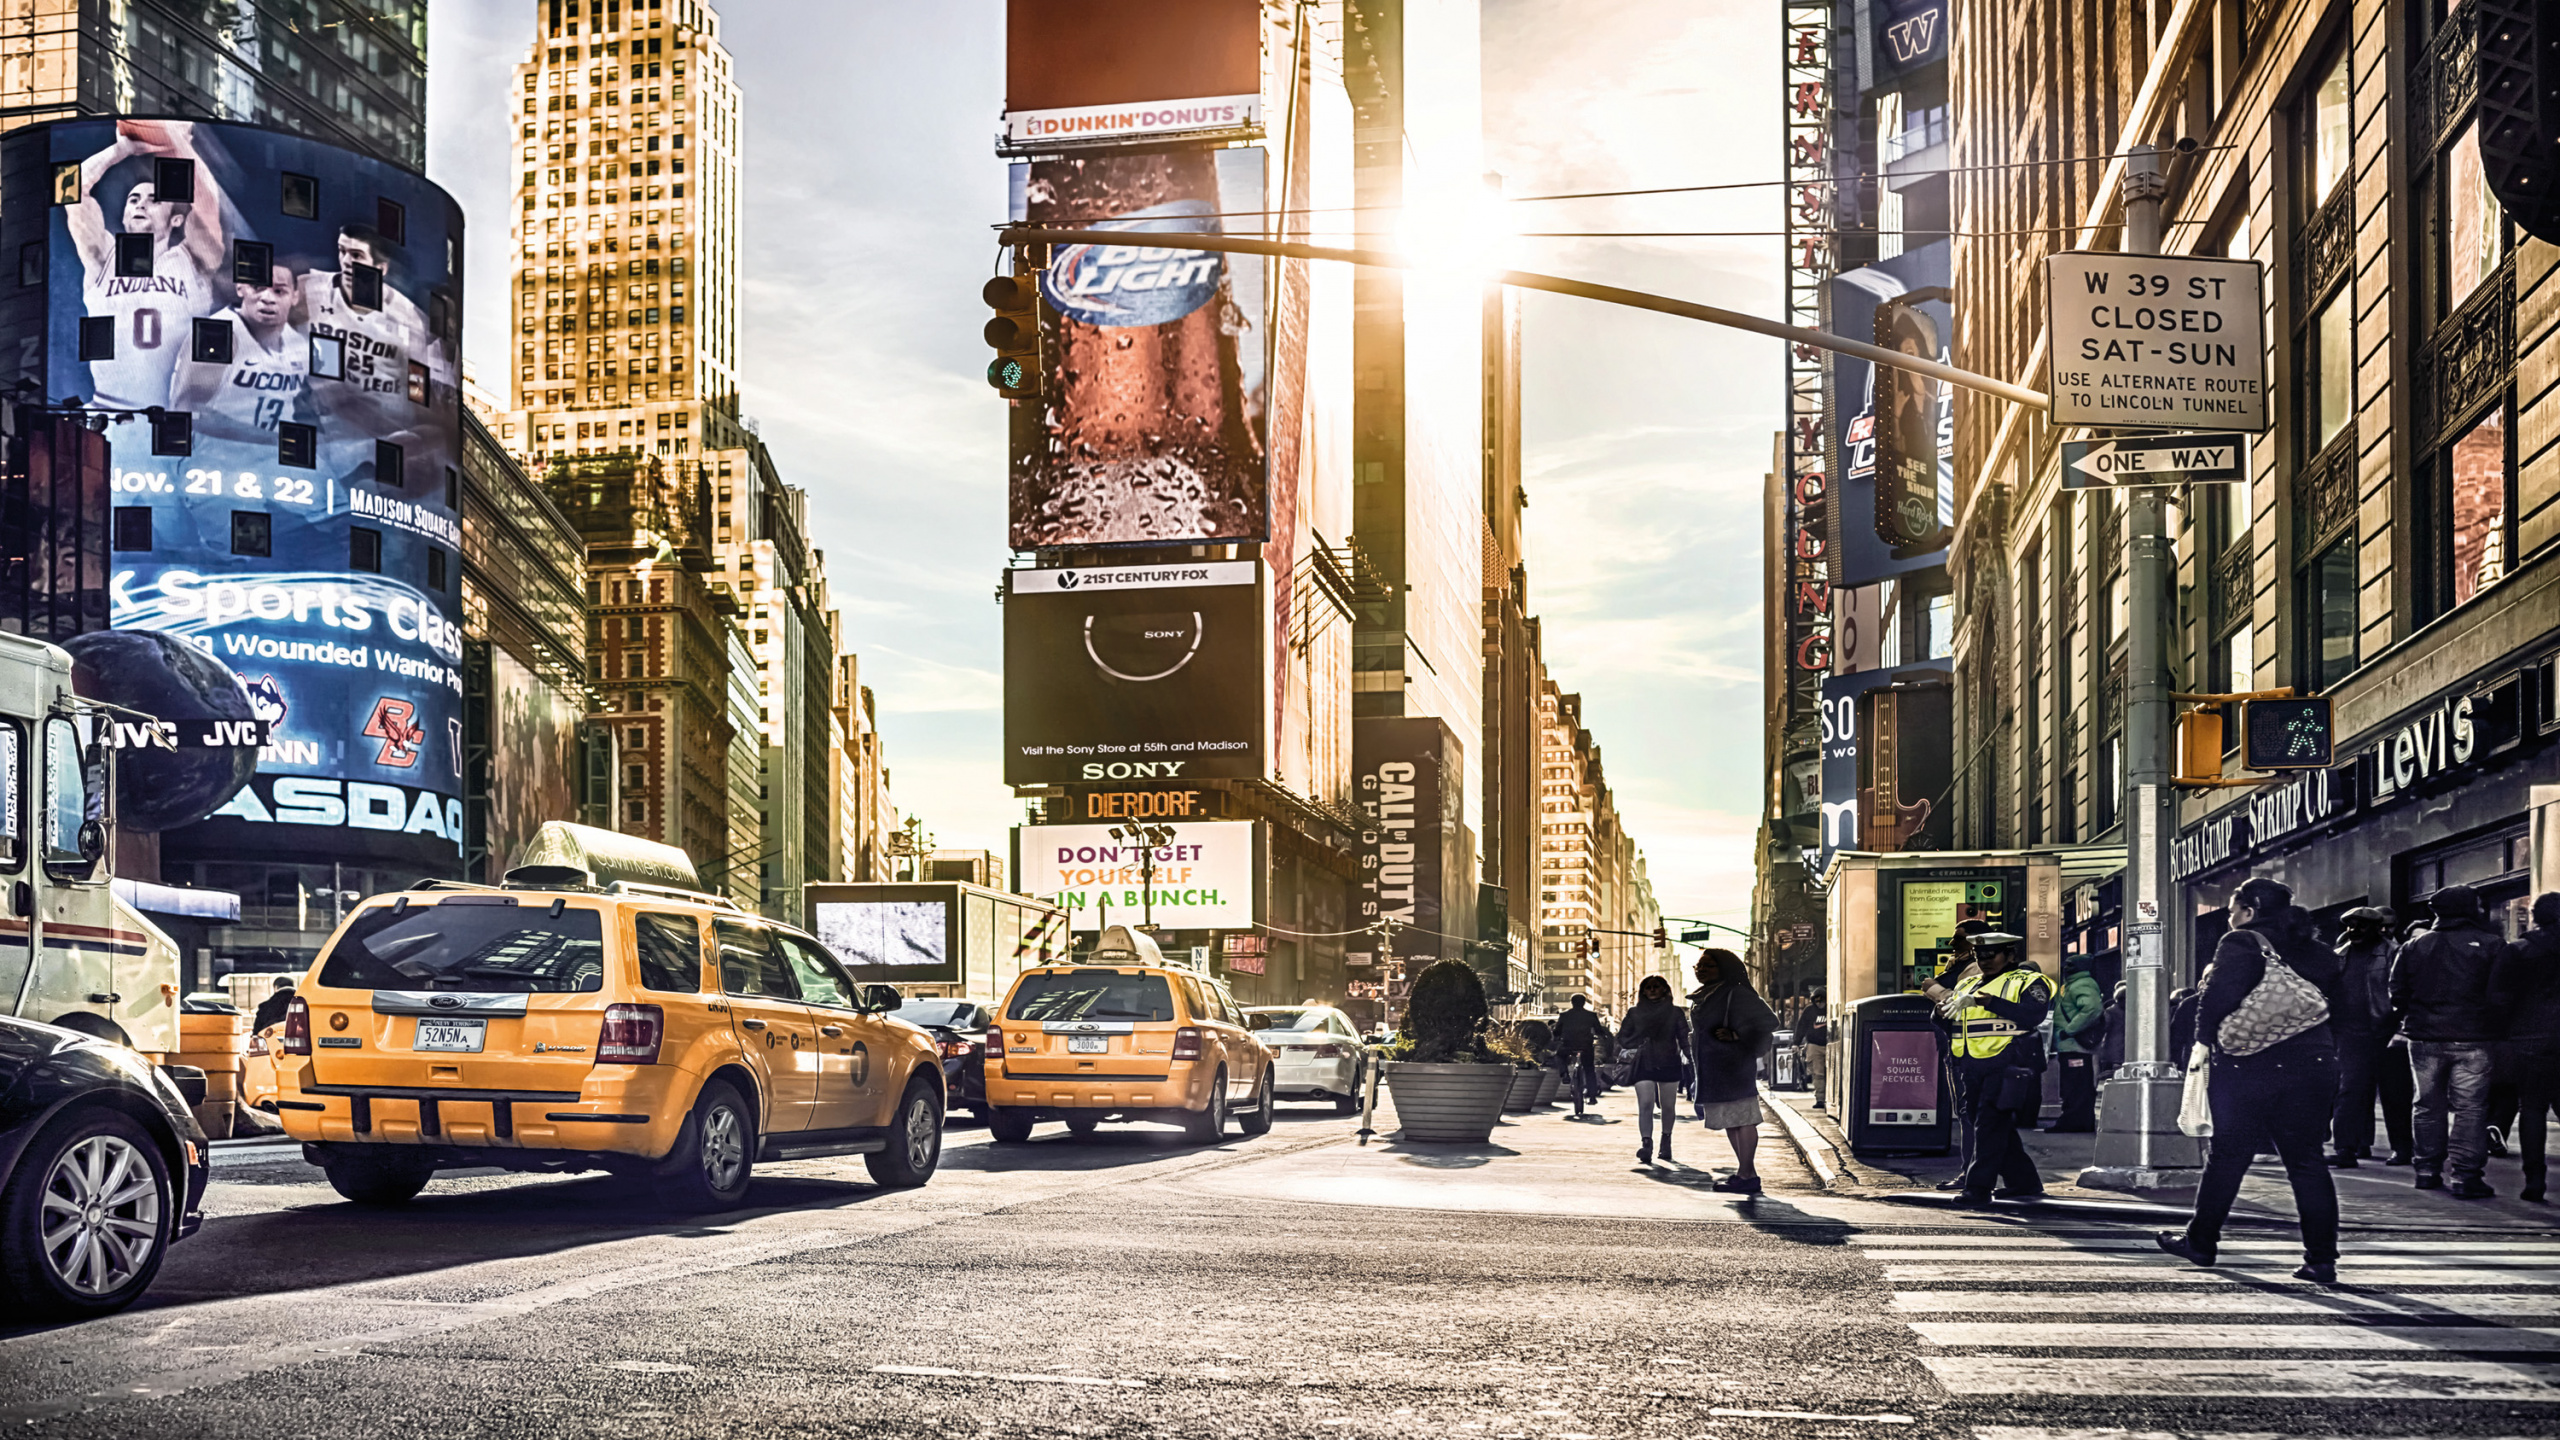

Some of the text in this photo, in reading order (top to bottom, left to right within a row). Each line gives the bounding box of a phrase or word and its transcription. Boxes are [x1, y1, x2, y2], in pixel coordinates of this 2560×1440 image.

[105, 275, 188, 300] INDIANA
[1071, 257, 1219, 296] LIGHT
[2084, 271, 2227, 300] W 39 ST
[2090, 305, 2223, 333] CLOSED
[2080, 337, 2236, 367] SAT-SUN
[233, 369, 306, 392] UCONN
[2057, 371, 2259, 394] USE ALTERNATE ROUTE
[2070, 392, 2248, 414] TO LINCOLN TUNNEL
[1905, 457, 1927, 475] SEE
[2096, 448, 2225, 473] ONE WAY
[1896, 464, 1917, 482] THE
[185, 468, 222, 496] 21
[233, 472, 263, 499] &
[273, 476, 314, 505] 22
[1906, 480, 1935, 500] SHOW
[350, 487, 413, 524] MADISON
[414, 504, 448, 539] SQUARE
[1083, 569, 1209, 585] 21ST CENTURY FOX
[157, 570, 373, 631] Sports
[1143, 630, 1185, 639] SONY
[223, 632, 368, 668] Wounded
[375, 648, 445, 685] Warrior
[203, 721, 258, 747] JVC
[1021, 740, 1249, 757] Visit the Sony Store at 55th and Madison
[1082, 761, 1186, 780] SONY
[1087, 790, 1207, 818] DIERDORF,
[2249, 767, 2332, 849] SHRIMP CO.
[1362, 773, 1378, 916] GHOSTS
[1394, 830, 1407, 842] OF
[1057, 844, 1203, 864] DON'T GET
[2169, 814, 2233, 884] BUBBA GUMP
[1058, 867, 1192, 886] YOURSELF
[1378, 843, 1416, 925] DUTY
[1057, 888, 1227, 908] IN A BUNCH.
[1909, 887, 1961, 895] Unlimited music
[1909, 895, 1950, 905] from Google
[2038, 876, 2050, 939] Newsstand
[1886, 1066, 1922, 1075] SQUARE
[1890, 1057, 1919, 1065] TIMES
[1882, 1075, 1926, 1083] RECYCLES
